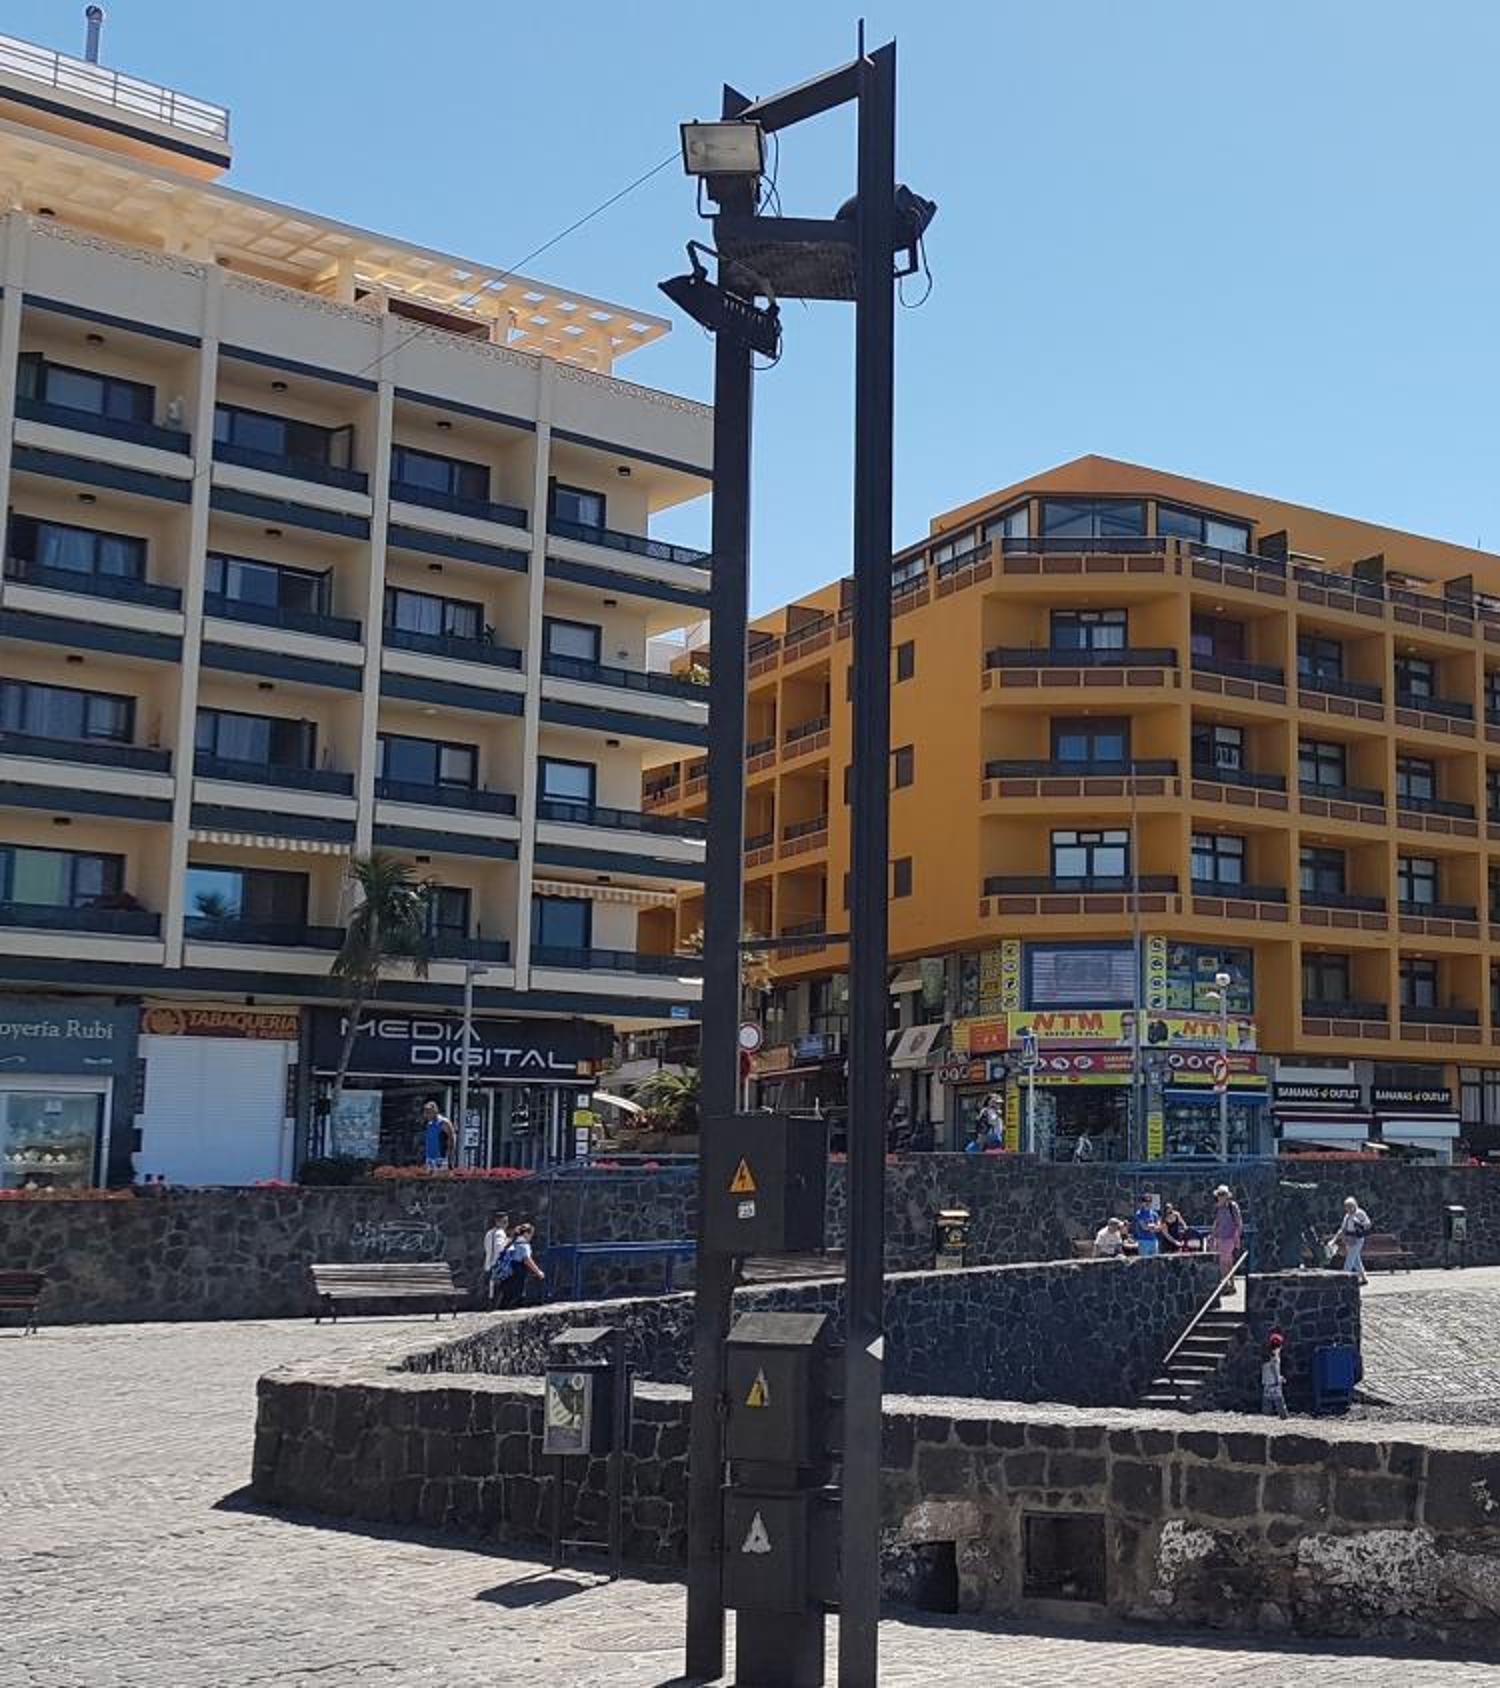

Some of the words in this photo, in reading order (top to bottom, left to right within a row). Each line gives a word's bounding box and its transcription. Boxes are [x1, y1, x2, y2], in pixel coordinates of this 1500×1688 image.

[340, 1018, 481, 1042] MEDIA
[1032, 1013, 1104, 1031] NTM
[410, 1045, 577, 1070] DIGITAL
[1329, 1088, 1361, 1099] OUTLET
